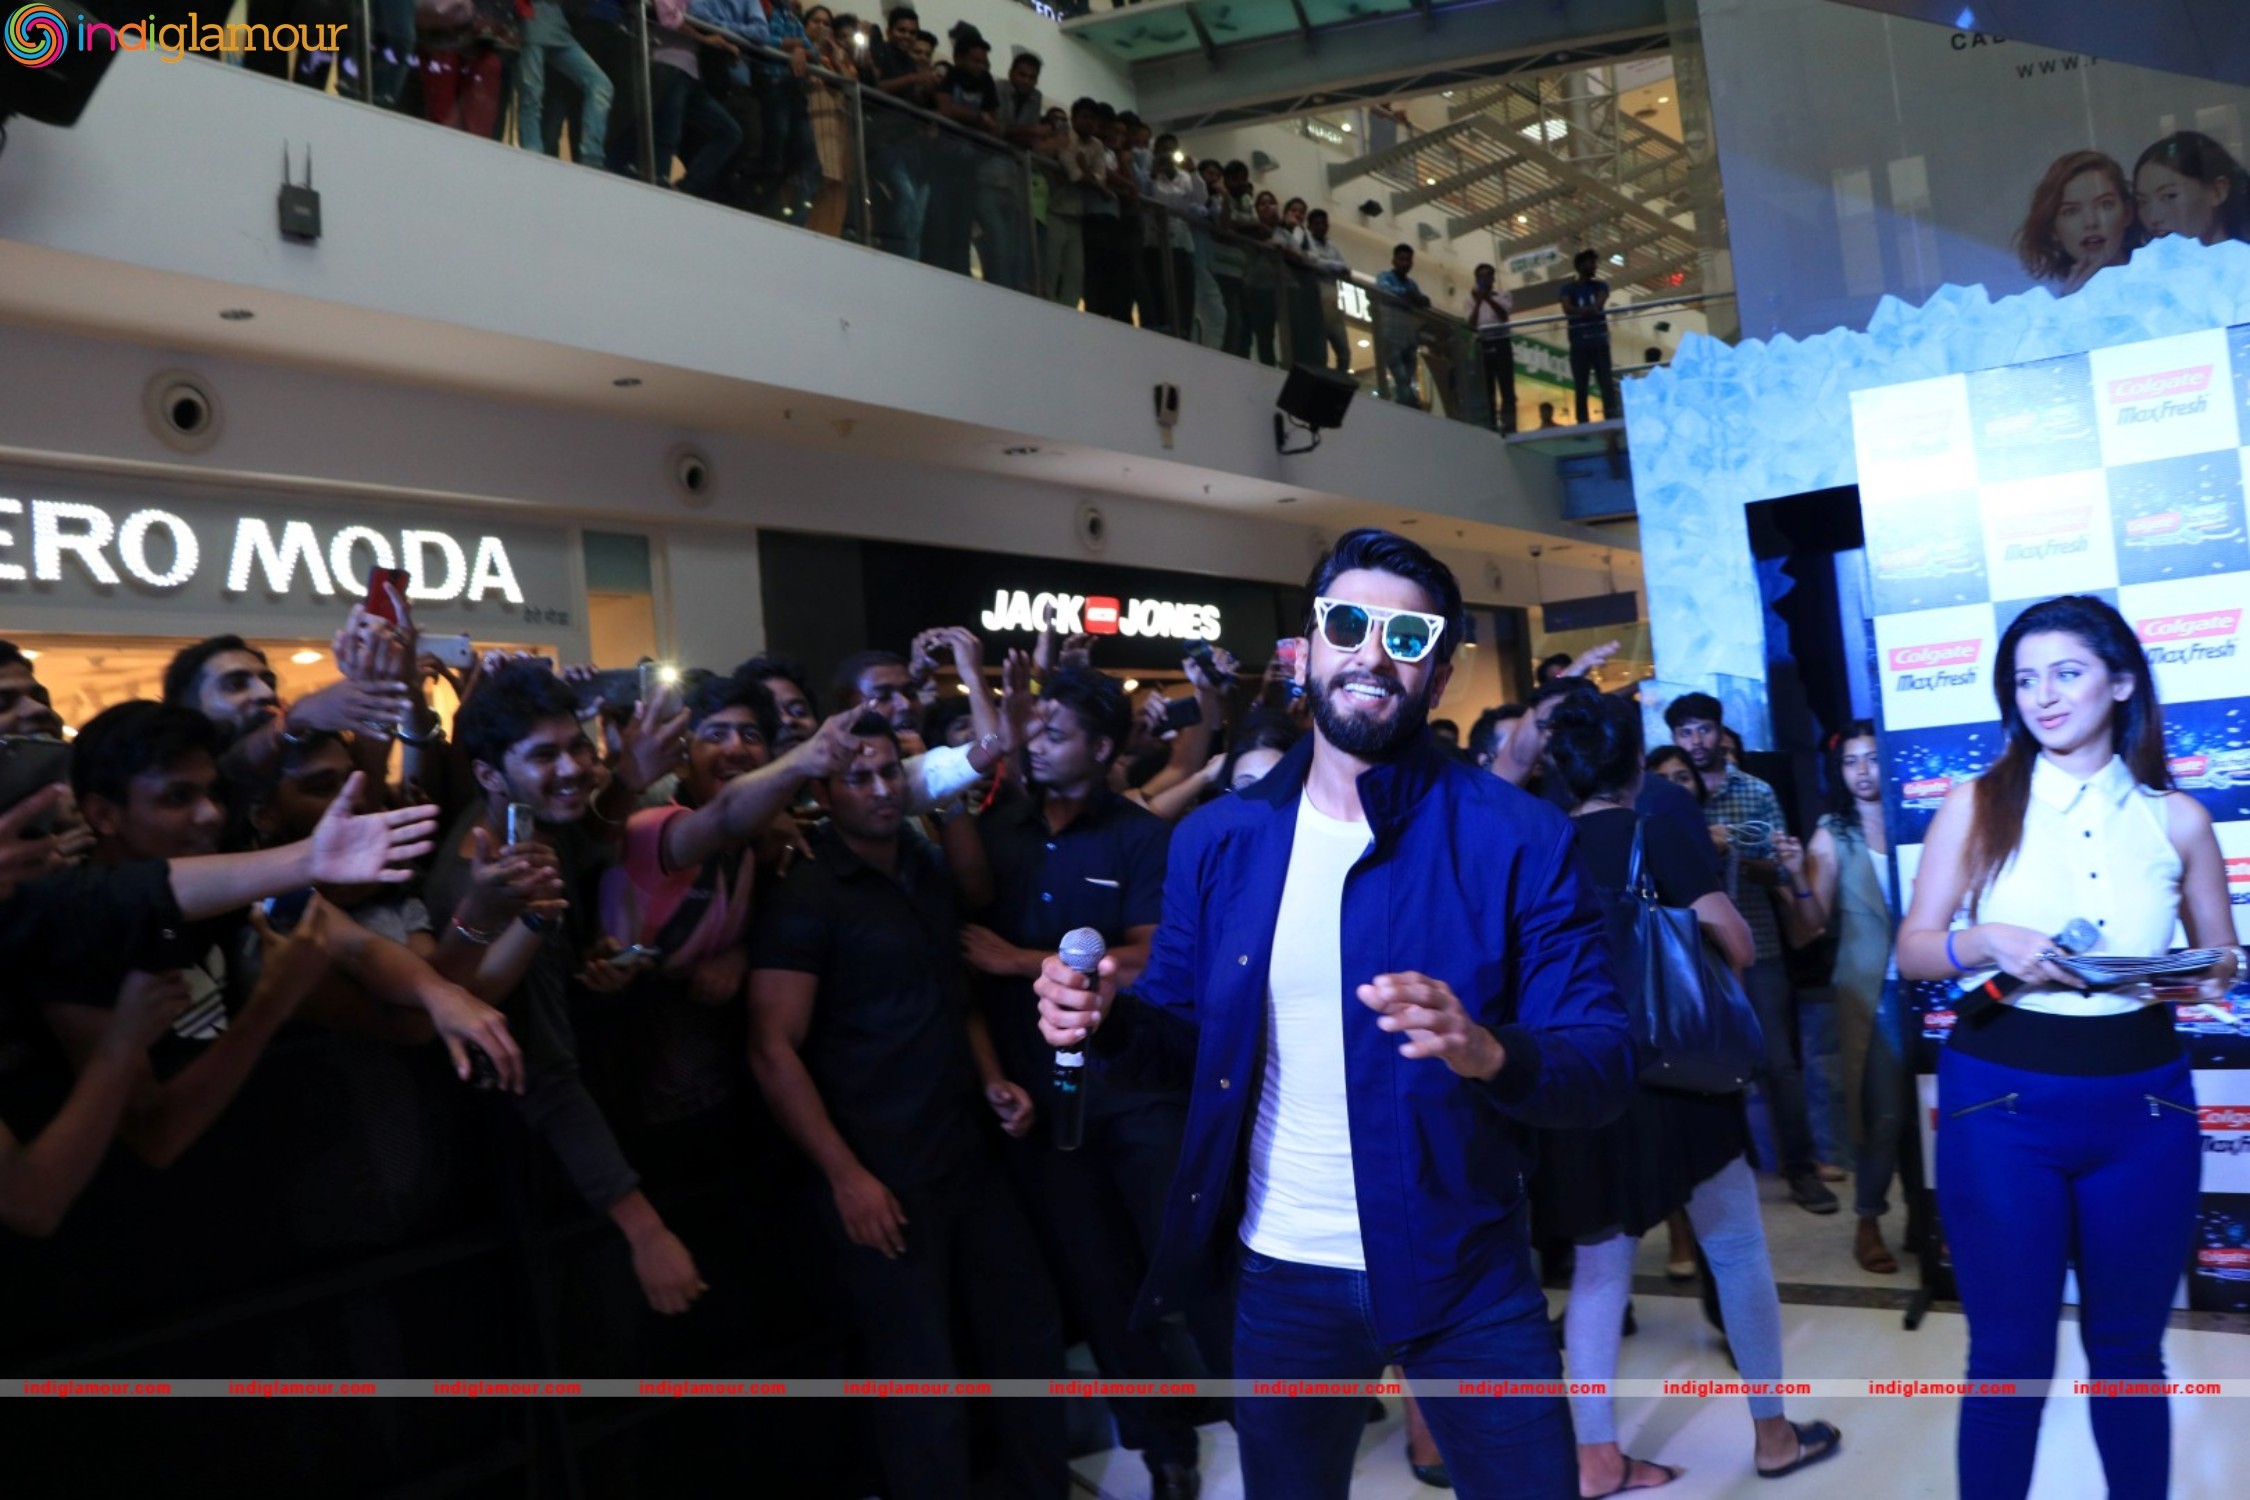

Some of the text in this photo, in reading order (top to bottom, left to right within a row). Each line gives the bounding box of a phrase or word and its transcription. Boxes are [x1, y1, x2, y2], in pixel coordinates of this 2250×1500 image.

[2115, 371, 2206, 397] Colgate
[226, 517, 524, 604] MODA
[982, 589, 1221, 641] JACK JONES
[2143, 615, 2234, 638] Colgate
[1895, 645, 1976, 666] Colgate
